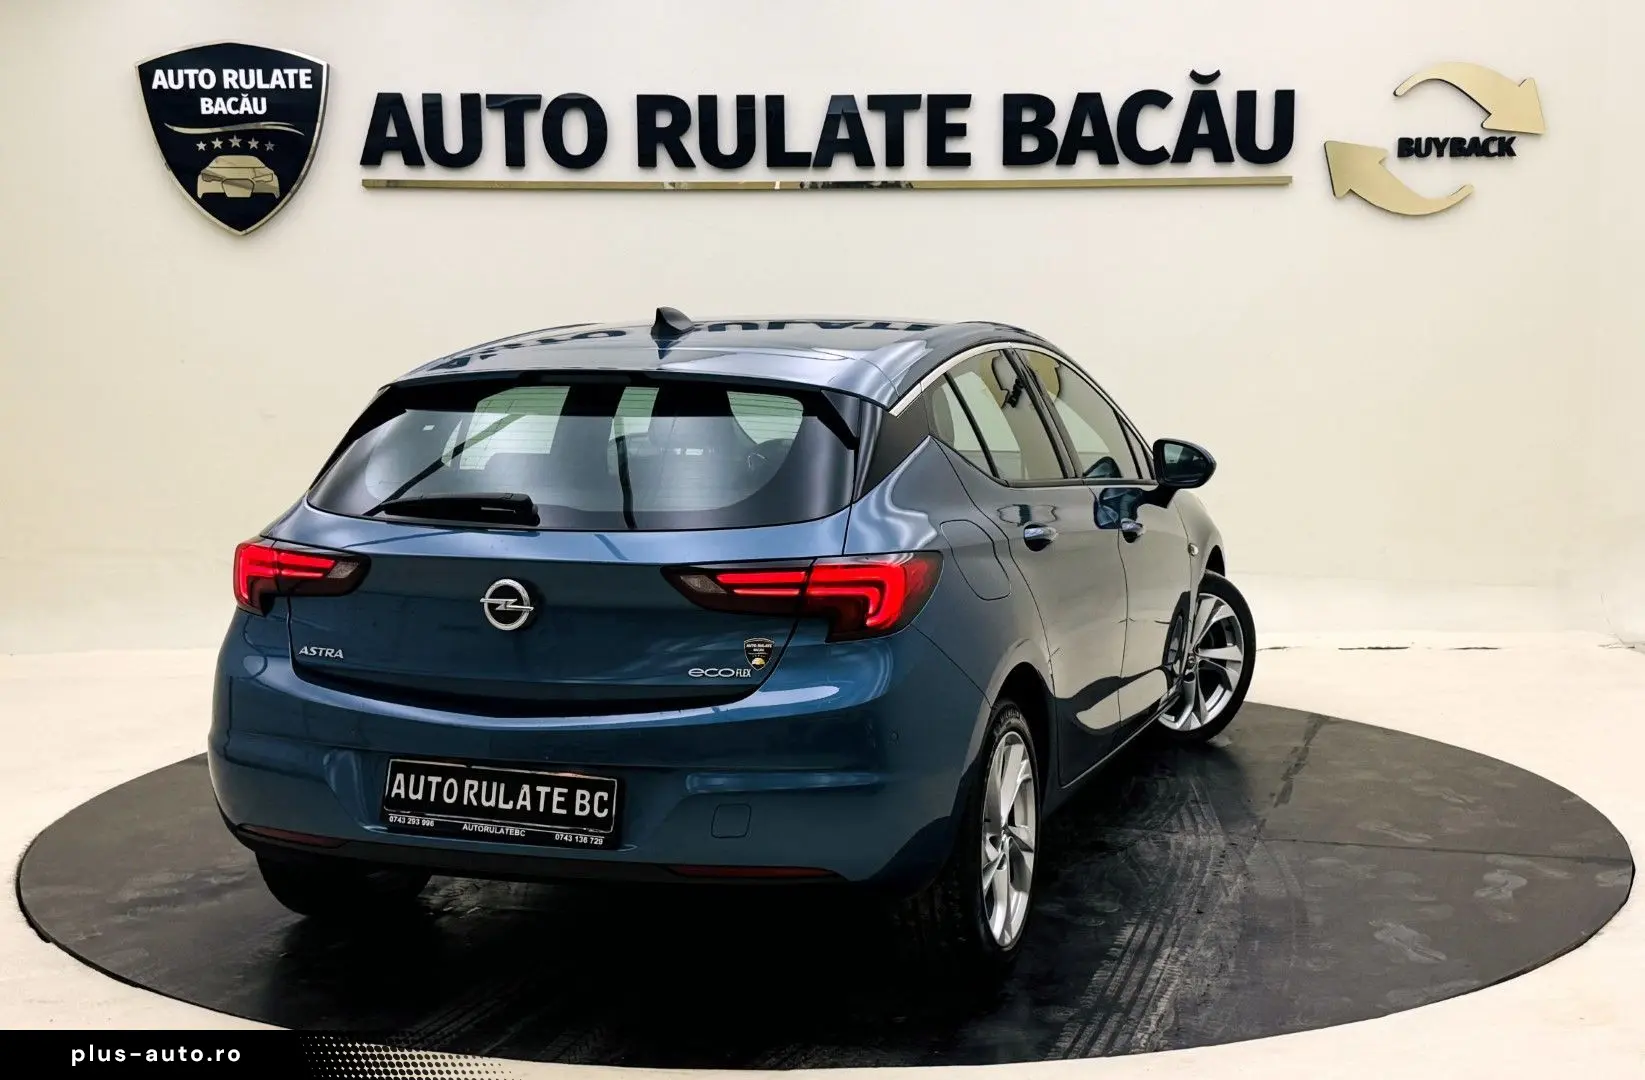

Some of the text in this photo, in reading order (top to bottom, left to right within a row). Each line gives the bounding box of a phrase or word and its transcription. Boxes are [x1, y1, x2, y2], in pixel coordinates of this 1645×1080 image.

[152, 67, 313, 91] AUTO RULATE
[200, 93, 268, 115] BACĂU
[360, 69, 1296, 170] AUTO RULATE BACĂU
[1397, 136, 1517, 158] BUYBACK
[298, 646, 344, 658] ASTRA
[391, 773, 609, 818] AUTO RULATE BC
[462, 823, 526, 837] AUTORULATEBC
[555, 833, 573, 842] 0743
